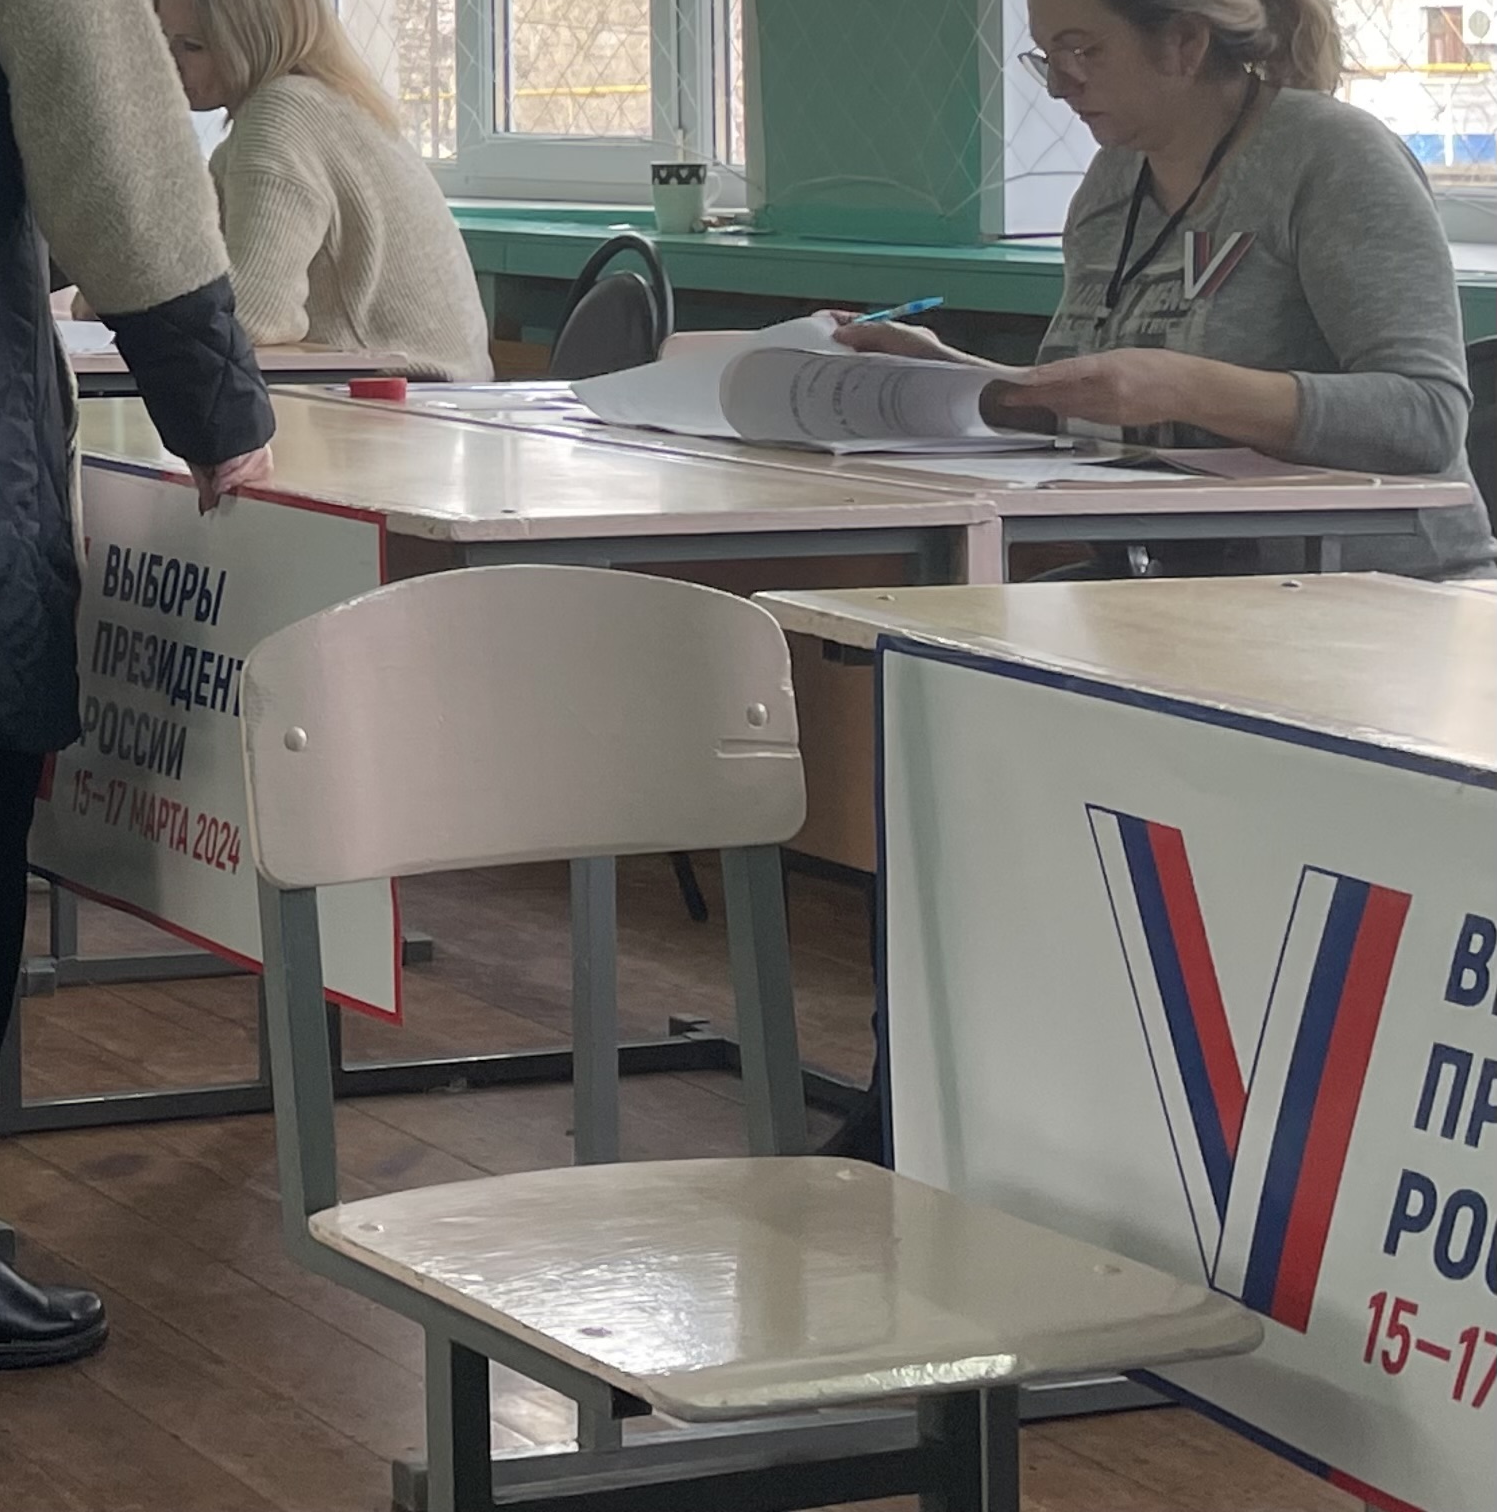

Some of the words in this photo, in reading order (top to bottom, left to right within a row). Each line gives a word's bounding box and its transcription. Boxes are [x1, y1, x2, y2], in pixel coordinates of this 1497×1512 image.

[103, 544, 227, 626] ВЫБОРЫ
[79, 696, 187, 781] РОССИИ
[128, 786, 189, 855] МАРТА
[192, 812, 241, 875] 2024
[1444, 912, 1497, 1017] В
[1383, 1167, 1497, 1297] РО
